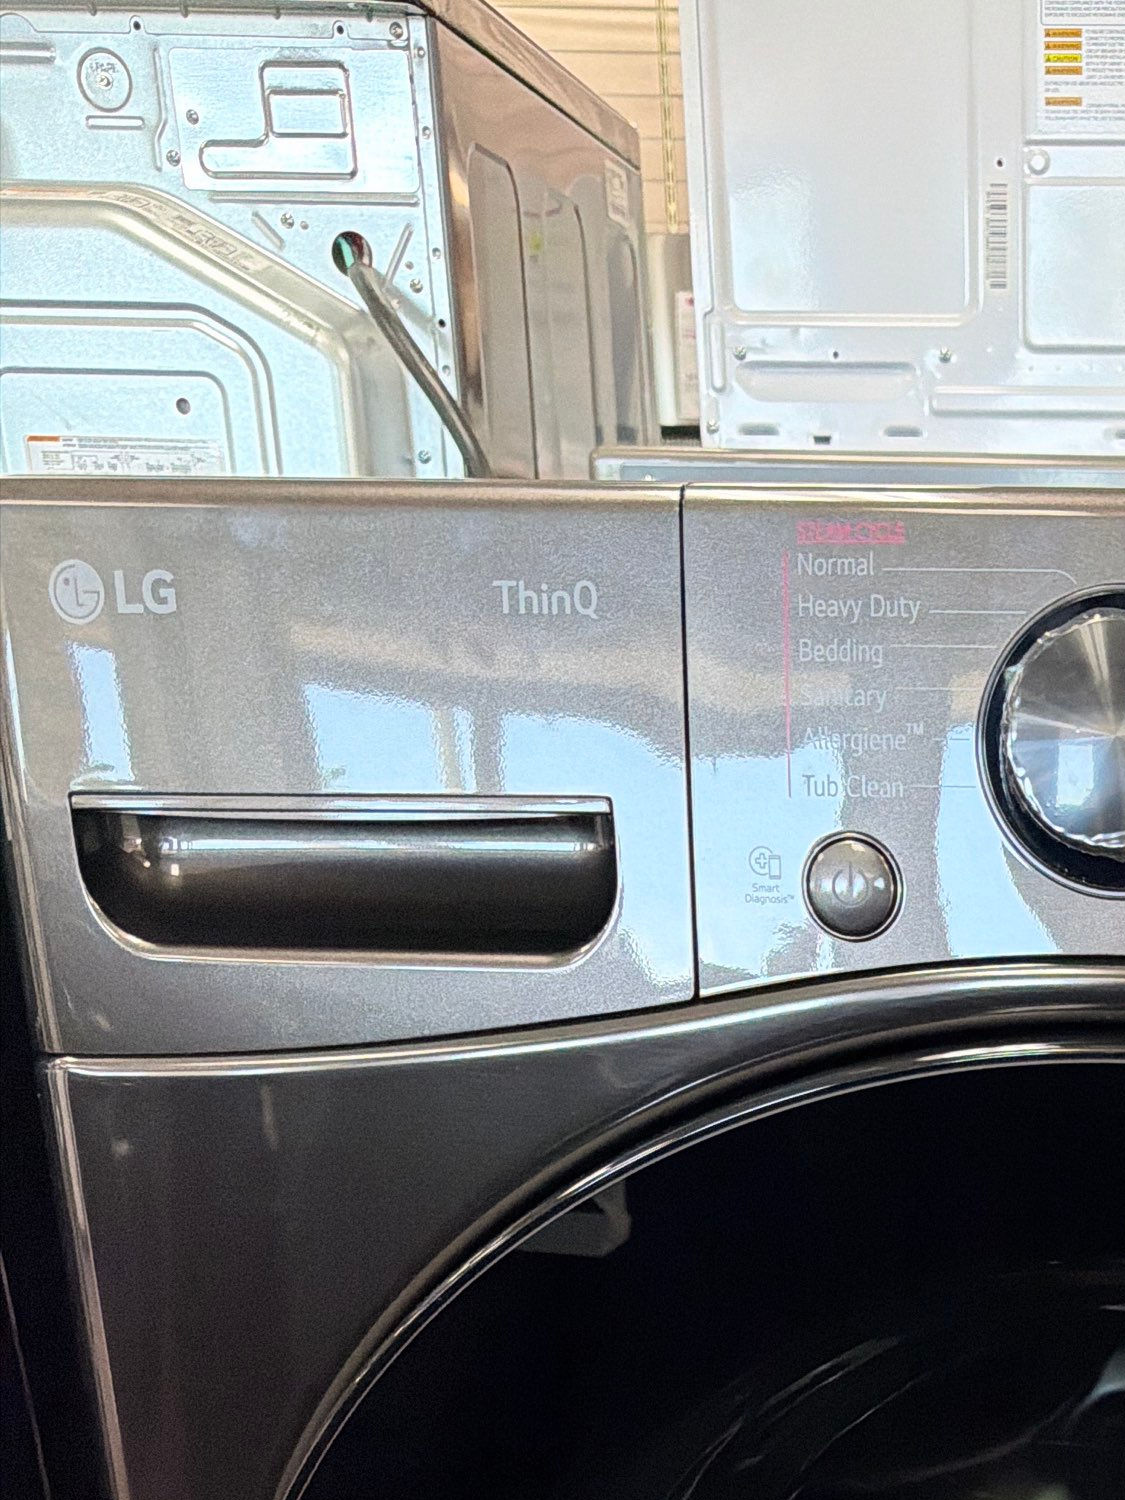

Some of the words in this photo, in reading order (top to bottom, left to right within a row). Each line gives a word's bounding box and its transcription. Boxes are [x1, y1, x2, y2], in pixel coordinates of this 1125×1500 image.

[797, 551, 874, 576] Normal
[112, 569, 177, 614] LG
[492, 579, 598, 619] ThinQ
[798, 593, 862, 624] Heavy
[870, 594, 921, 624] Duty
[799, 639, 883, 668] Bedding
[802, 774, 838, 797] Tub
[846, 775, 905, 798] Clean
[752, 883, 780, 893] Smart
